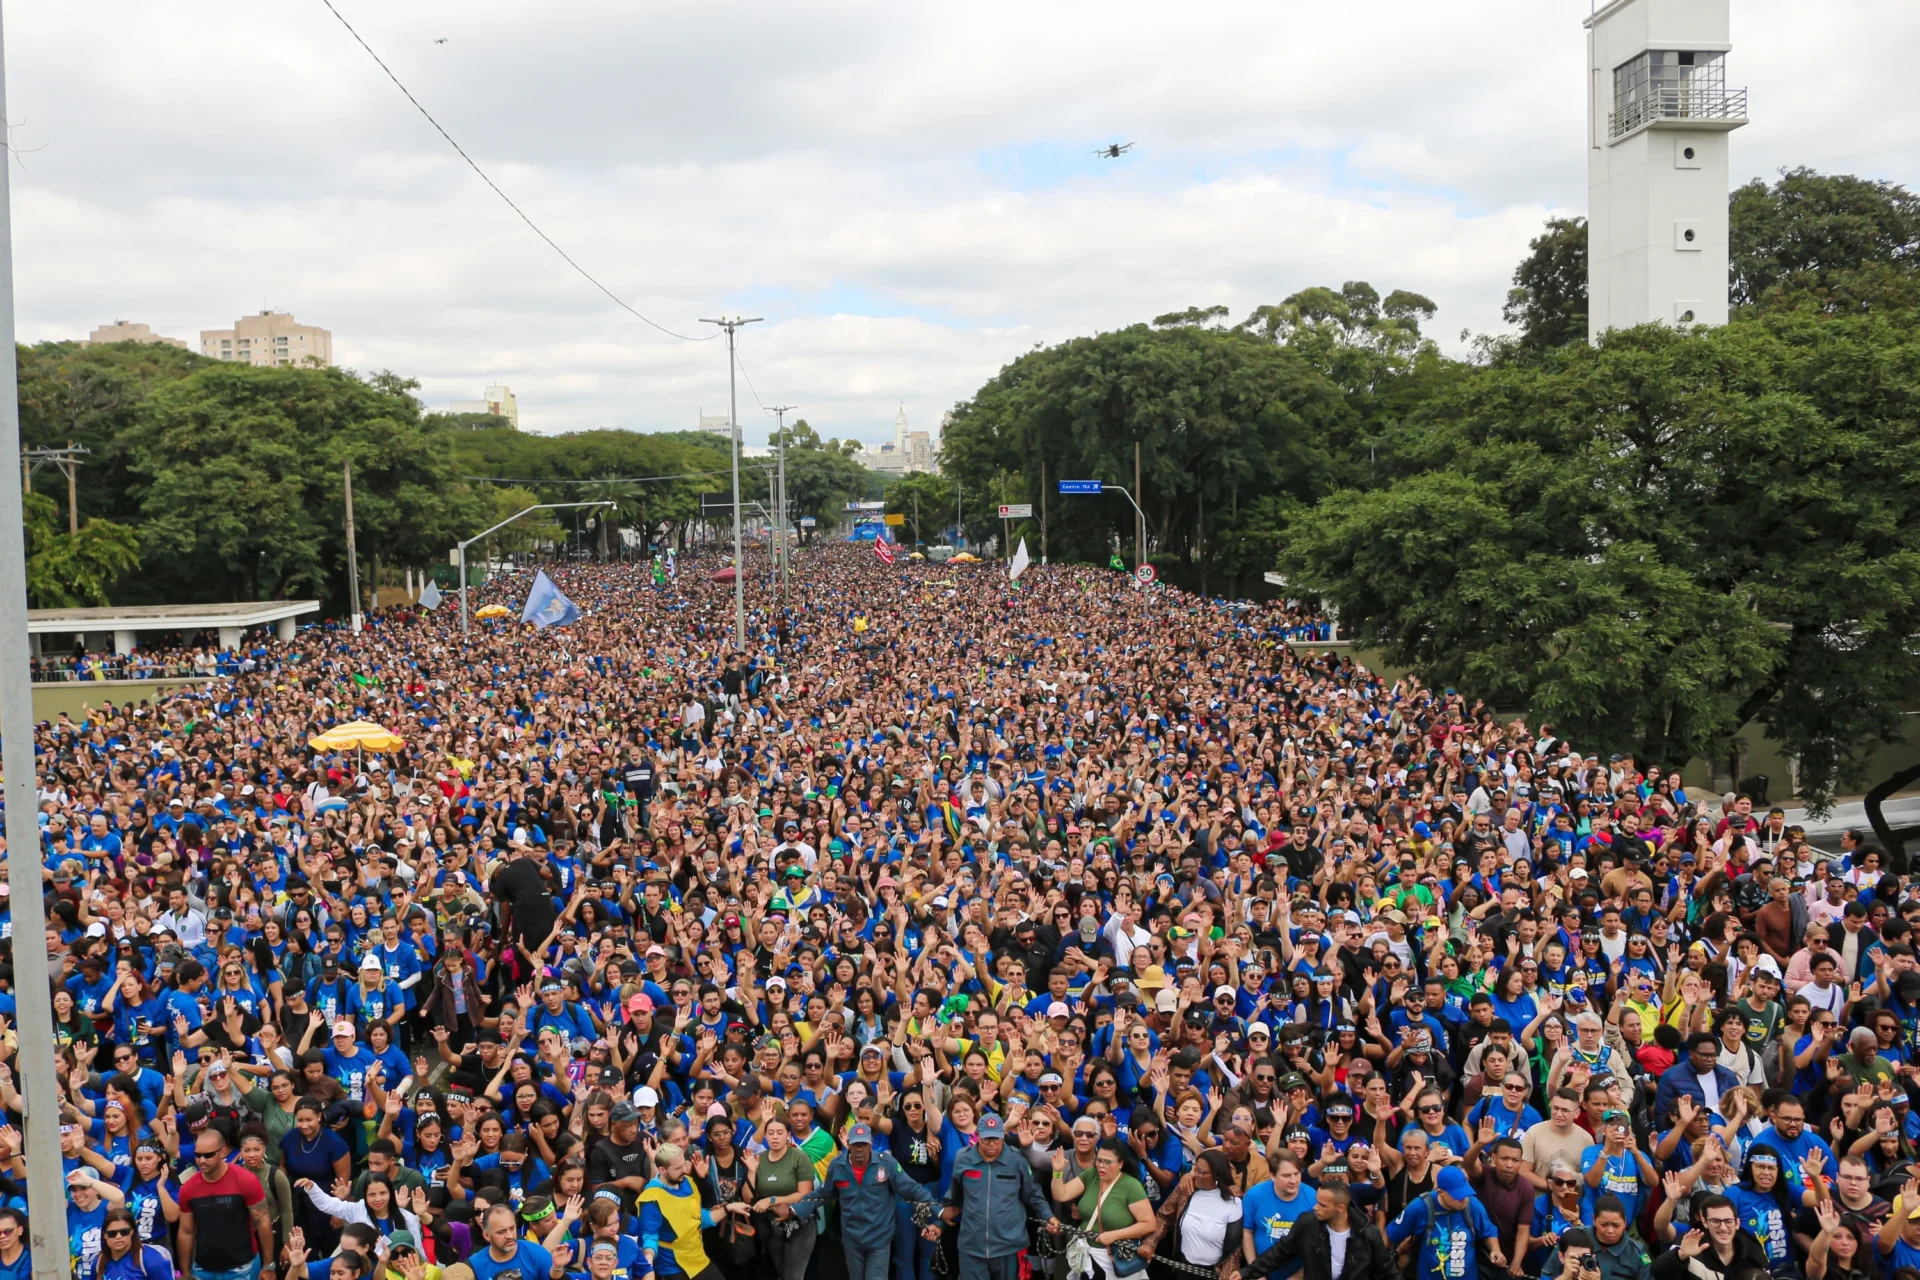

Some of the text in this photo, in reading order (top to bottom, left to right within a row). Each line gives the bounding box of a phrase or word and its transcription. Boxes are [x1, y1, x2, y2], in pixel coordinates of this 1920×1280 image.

[1139, 568, 1152, 577] 50
[1605, 1180, 1638, 1193] JESUS
[138, 1198, 158, 1241] JESUS
[1768, 1209, 1787, 1258] JESUS
[1450, 1231, 1467, 1277] JESUS
